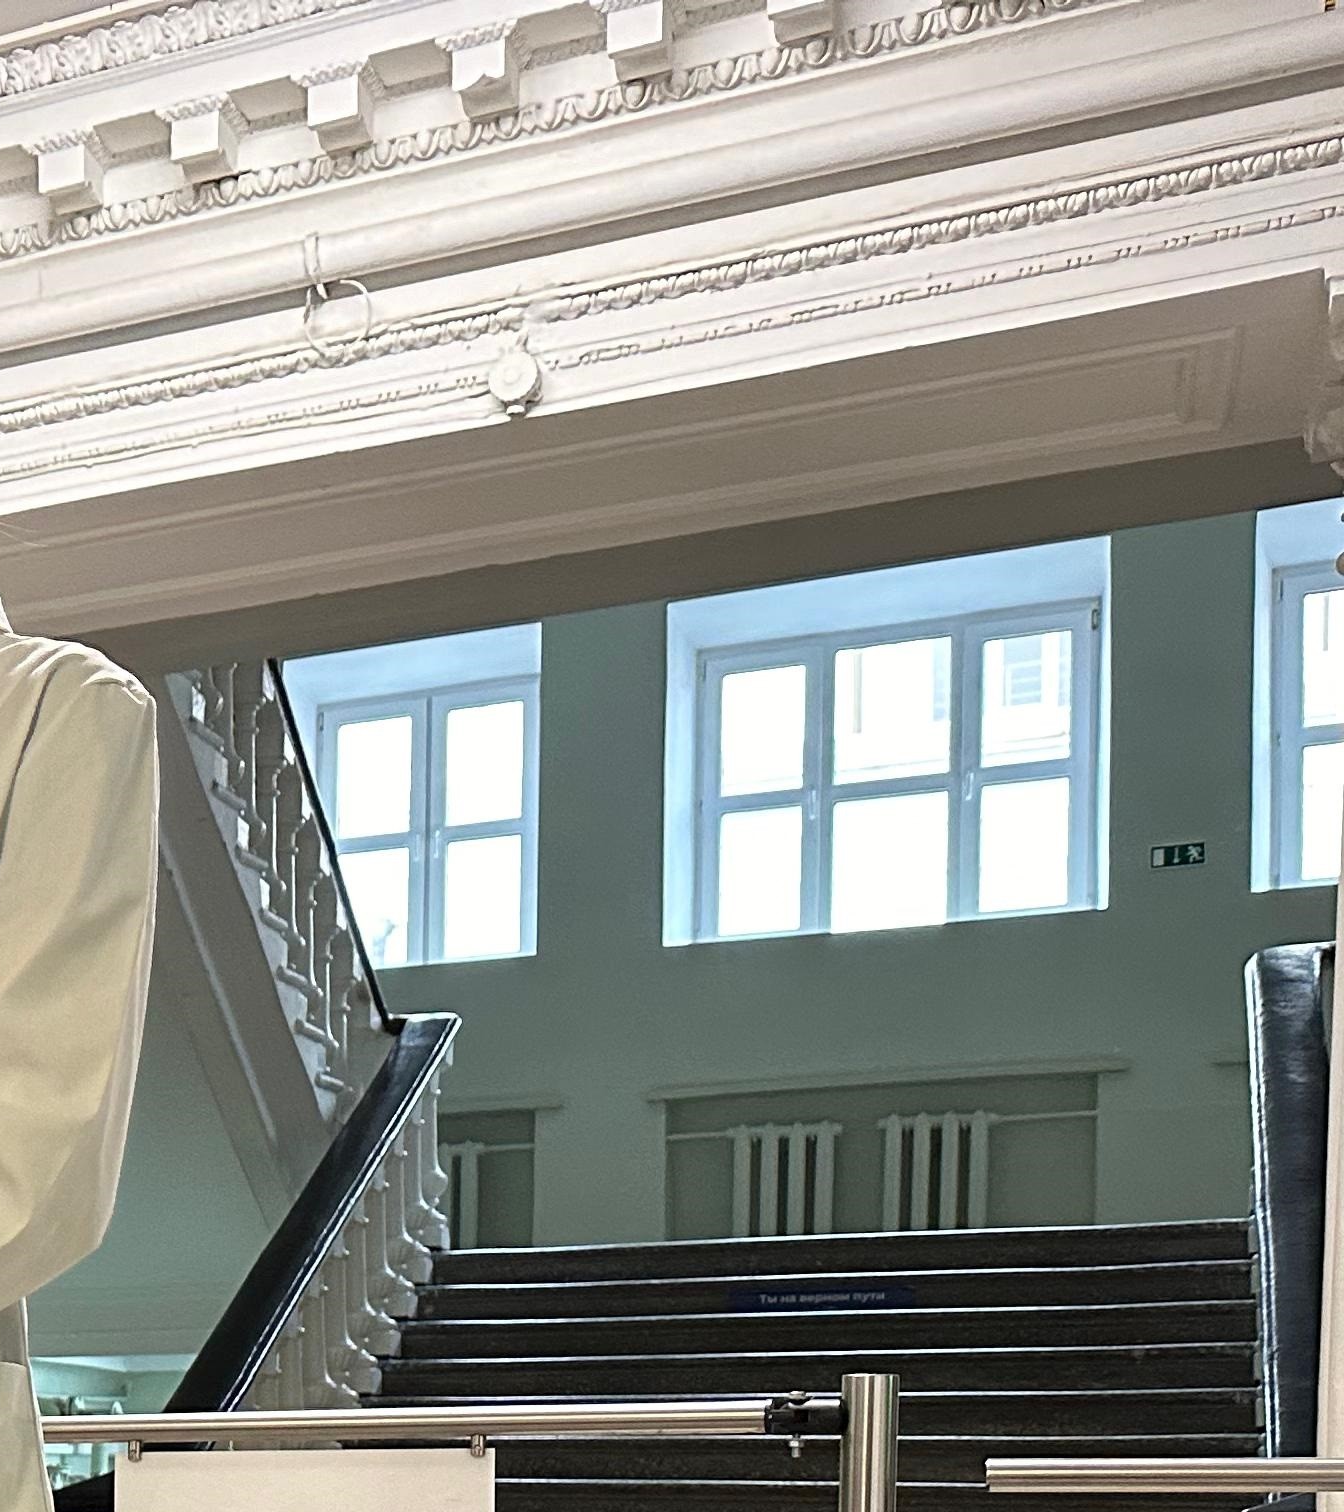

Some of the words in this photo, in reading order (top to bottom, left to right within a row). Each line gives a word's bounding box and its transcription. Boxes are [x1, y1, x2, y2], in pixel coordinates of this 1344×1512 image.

[760, 1293, 778, 1304] Ты
[780, 1293, 796, 1303] на
[799, 1292, 849, 1304] верном
[852, 1291, 885, 1303] пути
